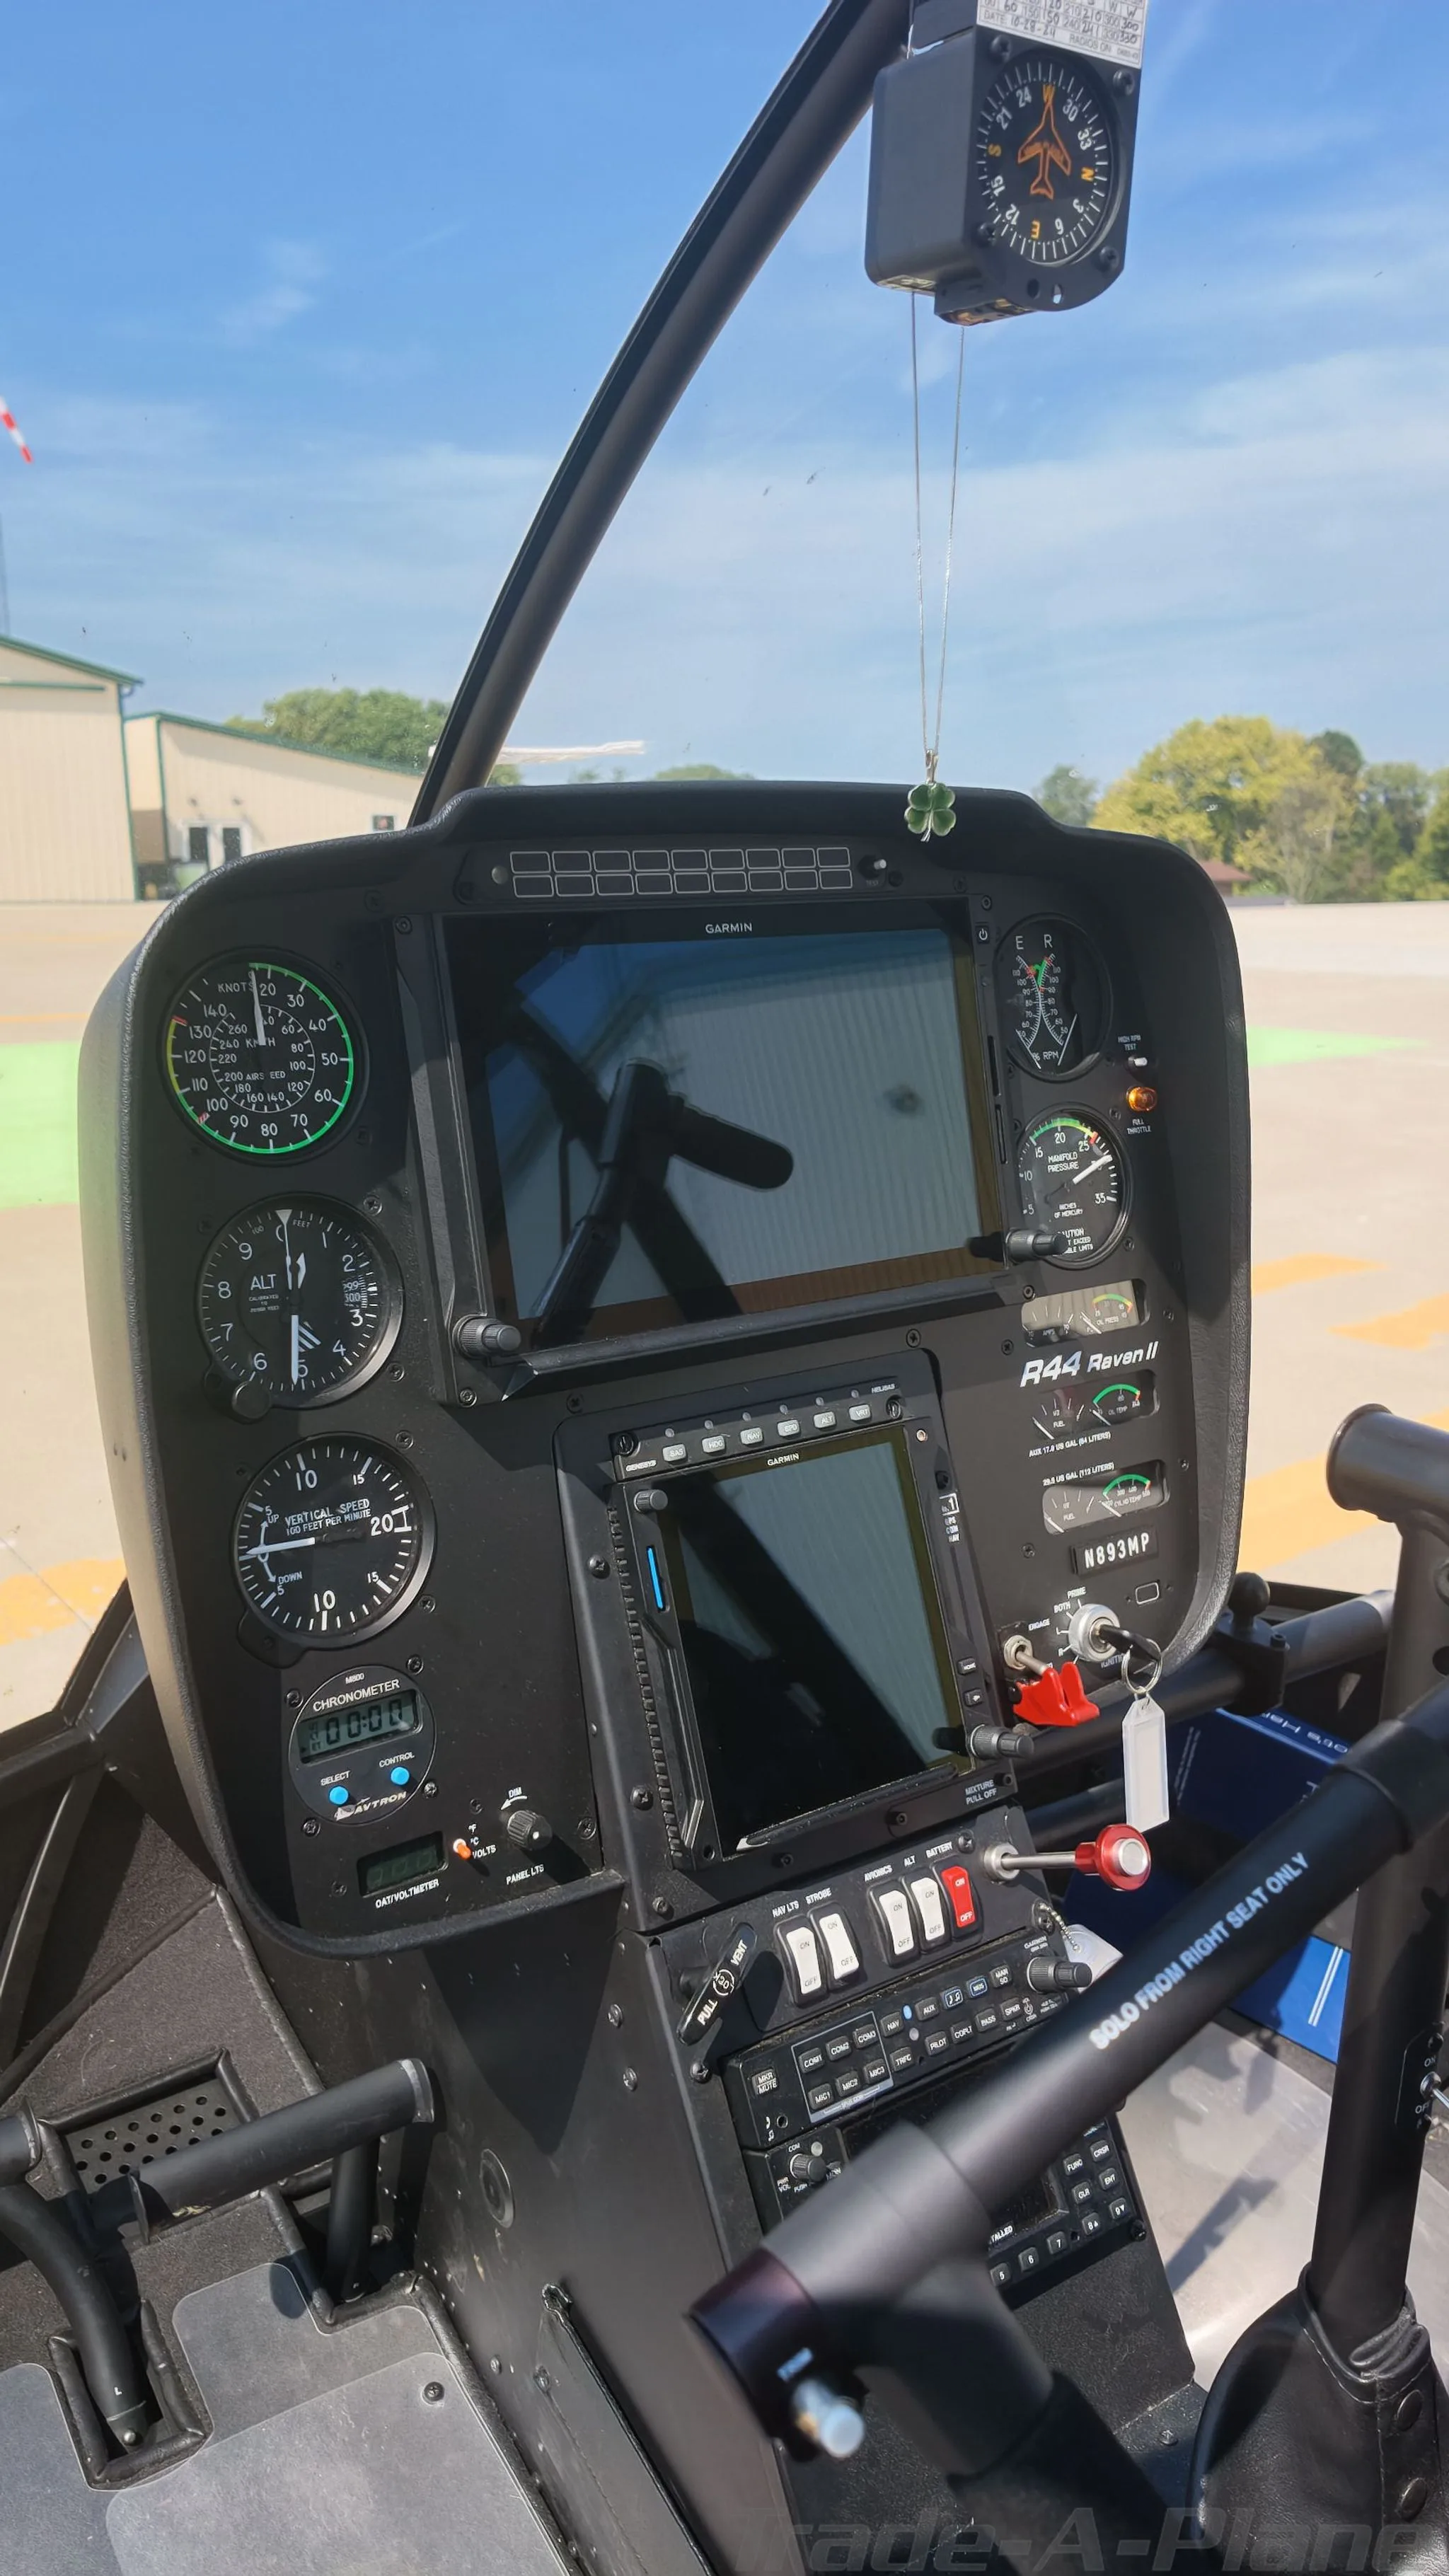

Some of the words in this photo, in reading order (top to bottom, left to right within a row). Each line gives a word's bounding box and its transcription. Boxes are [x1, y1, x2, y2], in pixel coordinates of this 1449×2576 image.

[1016, 86, 1032, 108] 24
[1042, 83, 1055, 103] W
[1063, 100, 1079, 122] 30
[996, 108, 1013, 130] 21
[1078, 129, 1092, 150] 33
[987, 144, 1002, 157] S
[1080, 168, 1095, 181] N
[1005, 204, 1020, 224] 12
[1030, 220, 1041, 239] E
[705, 923, 752, 934] GARMIN
[1015, 936, 1024, 949] E
[1044, 934, 1052, 948] R
[218, 982, 255, 993] KNOTS
[260, 983, 276, 996] 20
[287, 994, 304, 1007] 30
[204, 1004, 226, 1017] 140
[229, 1025, 247, 1034] 260
[282, 1025, 294, 1034] 60
[308, 1019, 326, 1031] 40
[189, 1026, 211, 1039] 130
[219, 1039, 239, 1049] 240
[291, 1044, 304, 1053] 80
[185, 1051, 206, 1063] 120
[218, 1054, 236, 1063] 220
[321, 1053, 337, 1065] 50
[1043, 1051, 1058, 1061] RPM
[289, 1061, 306, 1070] 100
[192, 1079, 208, 1090] 110
[235, 1084, 251, 1092] 180
[288, 1082, 304, 1091] 120
[248, 1093, 264, 1102] 160
[267, 1092, 284, 1102] 140
[314, 1090, 332, 1102] 60
[207, 1097, 228, 1111] 100
[230, 1115, 248, 1128] 90
[291, 1114, 308, 1126] 70
[261, 1124, 278, 1136] 80
[1054, 1133, 1066, 1143] 20
[1078, 1140, 1090, 1152] 25
[1035, 1149, 1044, 1158] 15
[1048, 1152, 1078, 1164] MANIFOLD
[1048, 1162, 1079, 1173] PRESSURE
[1024, 1172, 1032, 1181] 10
[1095, 1194, 1106, 1203] 35
[239, 1243, 252, 1259] 9
[342, 1255, 354, 1271] 2
[250, 1274, 277, 1290] ALT
[218, 1282, 231, 1298] 8
[350, 1310, 363, 1327] 3
[221, 1323, 233, 1341] 7
[333, 1340, 346, 1356] 4
[253, 1353, 267, 1370] 6
[1020, 1351, 1082, 1387] R44
[1087, 1347, 1143, 1372] Raven
[1145, 1341, 1159, 1360] II
[856, 1408, 869, 1417] VRT
[821, 1416, 833, 1424] ALT
[748, 1431, 761, 1440] NAV
[1066, 1440, 1078, 1448] GAL
[1088, 1431, 1111, 1444] LITERS)
[669, 1448, 683, 1457] SAS
[767, 1452, 799, 1466] GARMIN
[1066, 1472, 1078, 1481] GAL
[1092, 1462, 1114, 1475] LITERS)
[296, 1470, 317, 1491] 10
[353, 1474, 364, 1485] 15
[265, 1507, 272, 1516] 5
[285, 1507, 333, 1527] VERTICAL
[340, 1498, 369, 1513] SPEED
[268, 1515, 279, 1523] UP
[304, 1520, 323, 1532] FEET
[325, 1516, 342, 1527] PER
[344, 1509, 371, 1522] MINUTE
[371, 1514, 393, 1536] 20
[1084, 1532, 1150, 1569] N893MP
[279, 1571, 303, 1584] DOWN
[367, 1571, 379, 1582] 15
[277, 1586, 284, 1595] 5
[314, 1590, 335, 1612] 10
[1054, 1602, 1070, 1613] BOTH
[313, 1680, 400, 1711] CHRONOMETER
[325, 1699, 403, 1745] 00:00
[379, 1752, 415, 1767] CONTROL
[321, 1771, 350, 1786] SELECT
[509, 1787, 522, 1798] DIM
[965, 1780, 994, 1796] MIXTURE
[966, 1792, 983, 1804] PULL
[984, 1788, 997, 1798] OFF
[472, 1845, 497, 1859] VOLTS
[926, 1842, 952, 1857] BATTERY
[904, 1855, 916, 1867] ALT
[506, 1869, 530, 1885] PANEL
[531, 1864, 544, 1877] LTS
[864, 1865, 892, 1881] AVIONICS
[955, 1878, 965, 1887] ON
[375, 1878, 439, 1908] OAT/VOLTMETER
[806, 1888, 832, 1904] STROBE
[925, 1890, 935, 1899] ON
[772, 1904, 787, 1917] NAV
[787, 1900, 799, 1912] LTS
[894, 1902, 904, 1911] ON
[960, 1911, 972, 1921] OFF
[827, 1920, 838, 1930] ON
[929, 1924, 942, 1934] OFF
[799, 1940, 810, 1950] ON
[898, 1936, 911, 1947] OFF
[731, 1939, 747, 1965] VENT
[1090, 2002, 1140, 2050] SOLO
[1135, 1961, 1186, 2010] FROM
[1179, 1920, 1230, 1970] RIGHT
[1226, 1886, 1269, 1929] SEAT
[1266, 1852, 1309, 1894] ONLY
[841, 1956, 855, 1966] OFF
[697, 1999, 718, 2026] PULL
[923, 2004, 935, 2015] AUX
[1005, 2004, 1020, 2016] SPKR
[887, 2020, 899, 2031] NAV
[981, 2015, 996, 2027] PASS
[858, 2031, 877, 2043] COM3
[954, 2026, 972, 2038] COPLT
[831, 2042, 849, 2055] COM2
[930, 2038, 946, 2050] PILOT
[804, 2055, 822, 2068] COM1
[896, 2054, 911, 2066] TRFC
[758, 2072, 773, 2084] MKR
[869, 2066, 885, 2078] MIC3
[758, 2078, 778, 2094] MUTE
[842, 2079, 858, 2091] MIC2
[815, 2091, 831, 2103] MIC1
[788, 2142, 800, 2152] COM
[1093, 2145, 1109, 2158] CRSR
[1067, 2159, 1083, 2171] FUNC
[1104, 2174, 1116, 2185] ENT
[1056, 2239, 1061, 2248] 7
[1028, 2255, 1034, 2264] 6
[999, 2271, 1005, 2280] 5
